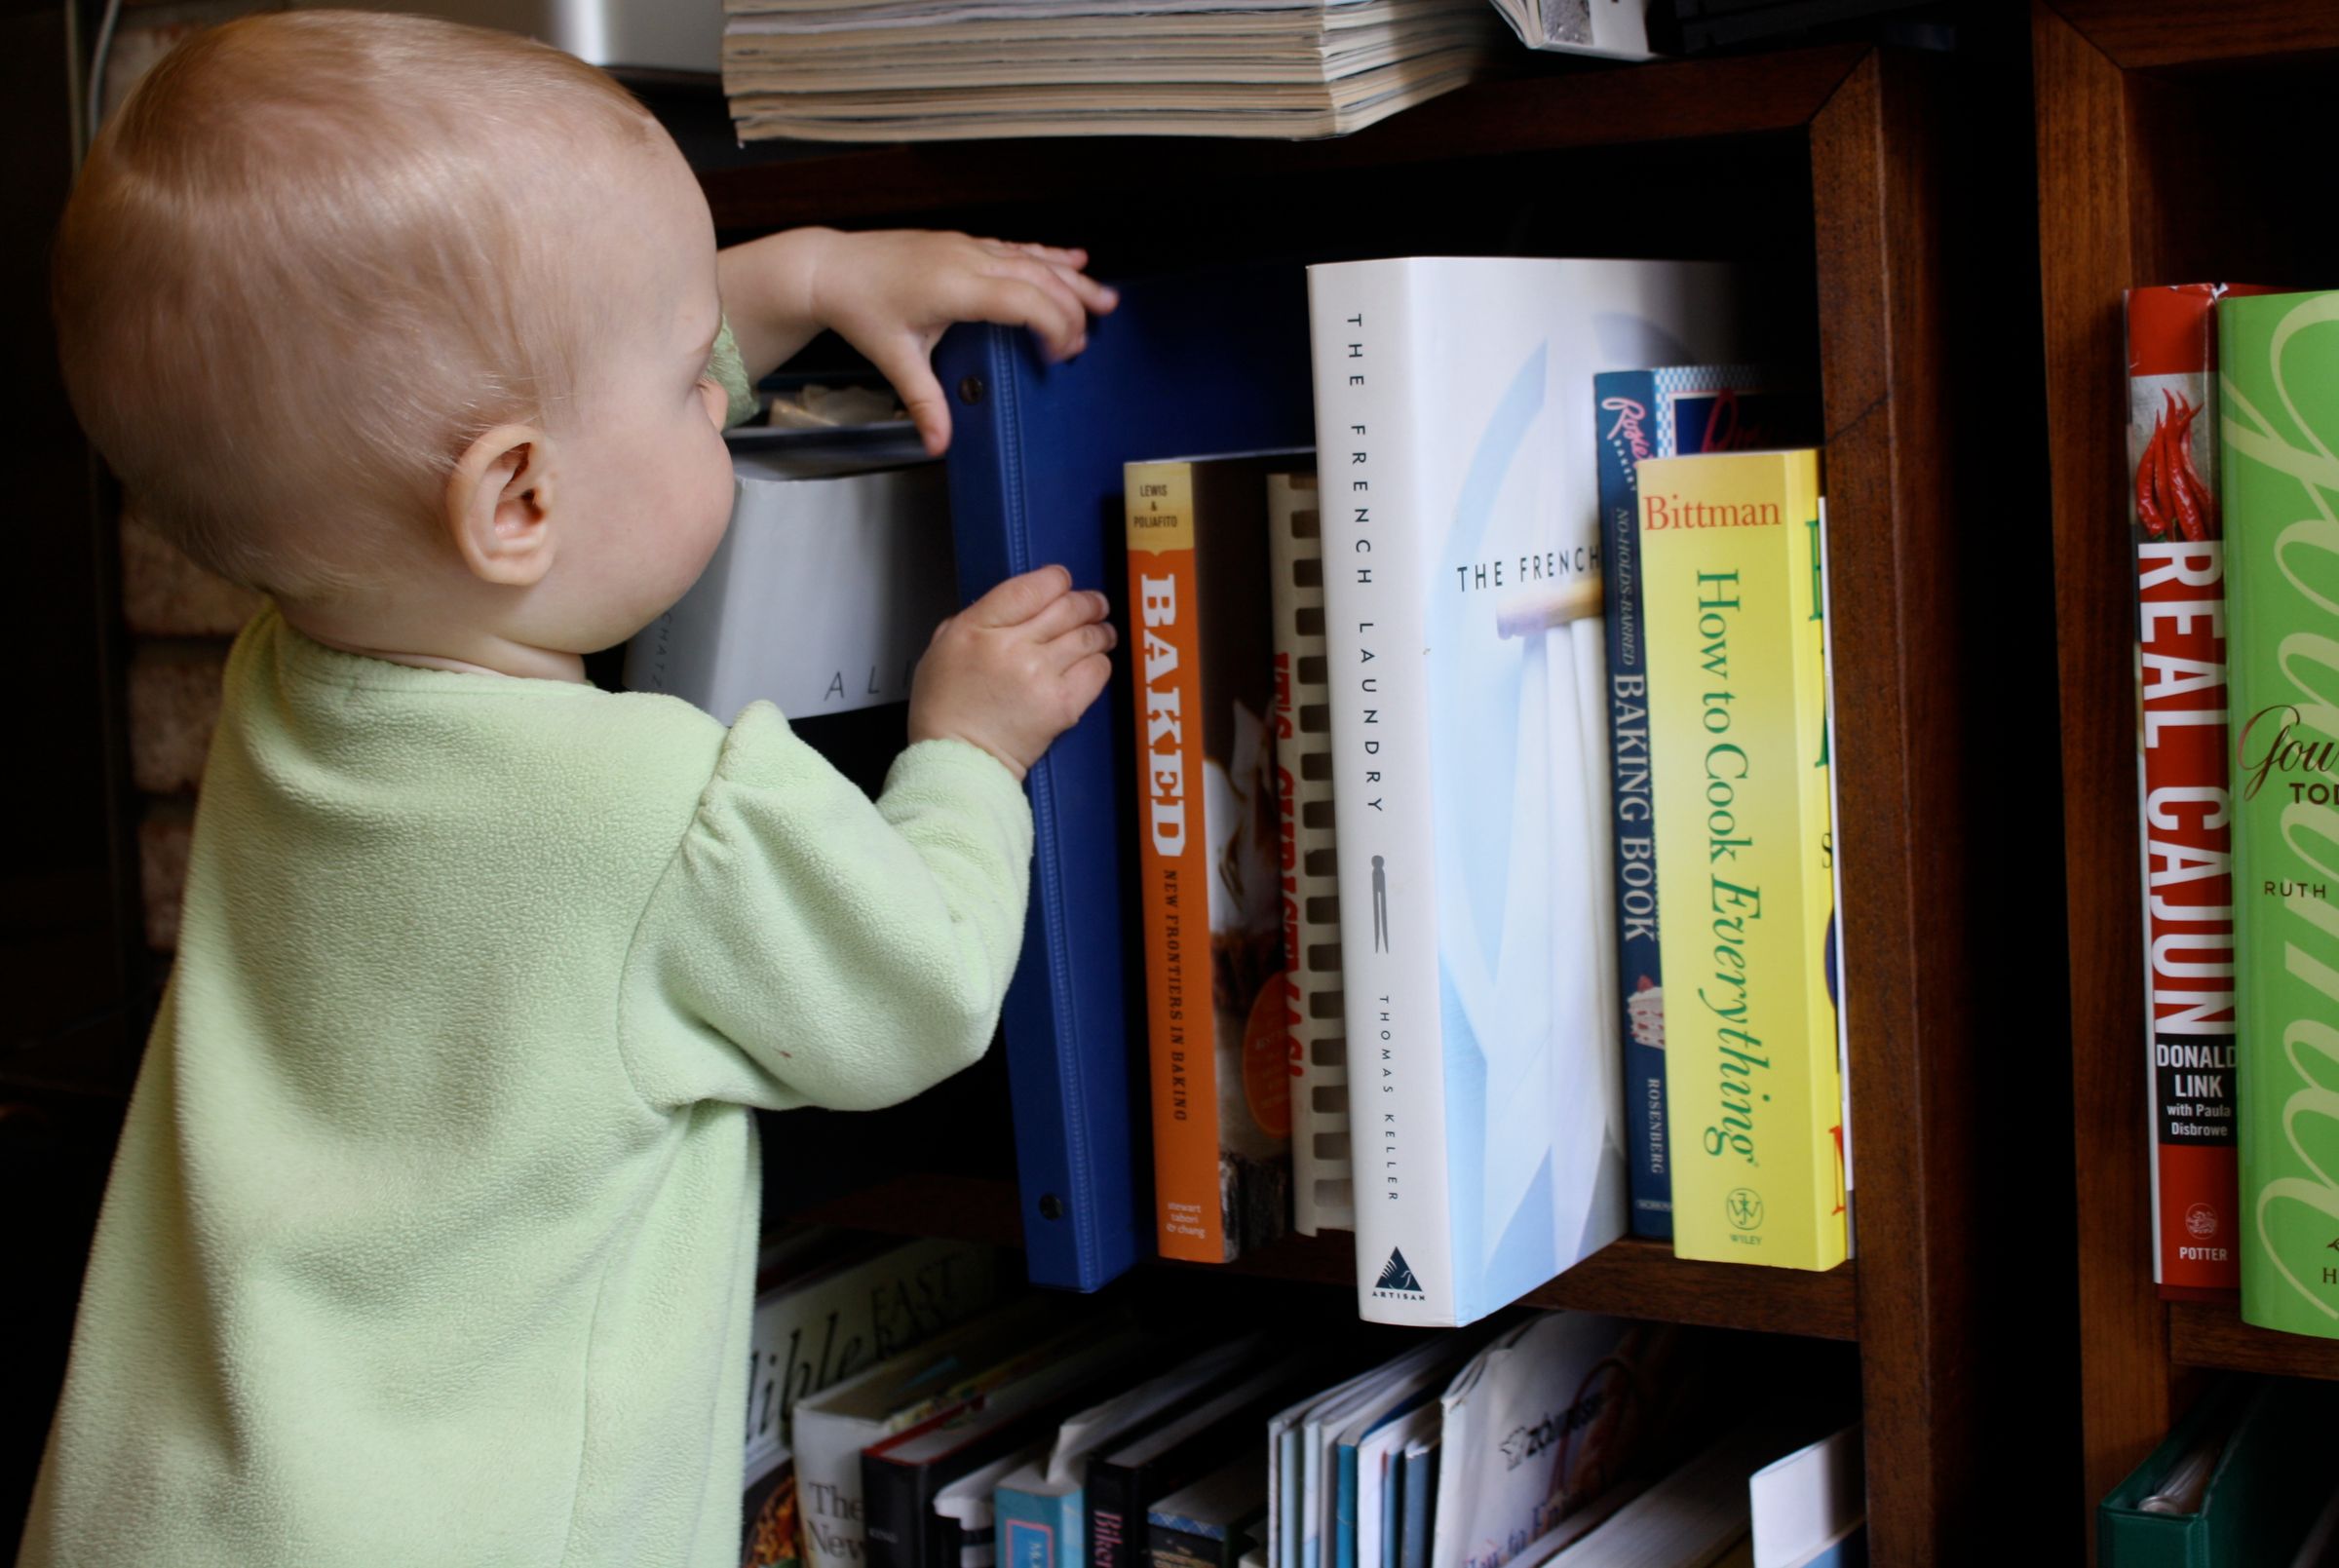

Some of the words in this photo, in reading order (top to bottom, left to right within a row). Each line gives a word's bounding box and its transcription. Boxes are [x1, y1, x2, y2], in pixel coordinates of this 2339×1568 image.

[1347, 313, 1364, 387] THE
[1139, 484, 1168, 497] LEWIS
[1150, 500, 1158, 512] &
[1351, 425, 1372, 583] FRENCH
[1644, 494, 1783, 531] Bittman
[1456, 561, 1504, 593] THE
[1519, 546, 1600, 583] FRENCH
[1697, 569, 1741, 680] How
[2138, 540, 2226, 748] REAL
[1140, 573, 1186, 857] BAKED
[1359, 623, 1382, 812] LAUNDRY
[1614, 673, 1651, 822] BAKING
[1702, 691, 1737, 734] to
[1706, 744, 1753, 864] Cook
[1164, 869, 1178, 907] NEW
[1620, 836, 1656, 942] BOOK
[2146, 786, 2236, 1035] CAJUN
[2264, 881, 2327, 899] RUTH
[1166, 914, 1182, 1020] FRONTIERS
[1170, 1026, 1184, 1045] IN
[1379, 995, 1394, 1092] THOMAS
[1698, 873, 1771, 1164] Everything
[1171, 1051, 1187, 1121] BAKING
[2156, 1043, 2237, 1068] DONALD
[2174, 1074, 2223, 1098] LINK
[1647, 1078, 1665, 1174] ROSENBERG
[2166, 1103, 2193, 1117] with
[2196, 1103, 2232, 1118] Paula
[2171, 1121, 2229, 1137] Disbrowe
[1385, 1114, 1399, 1201] KELLER
[1730, 1233, 1763, 1246] WILEY
[2179, 1246, 2229, 1261] POTTER
[1372, 1291, 1426, 1302] ARTISAN
